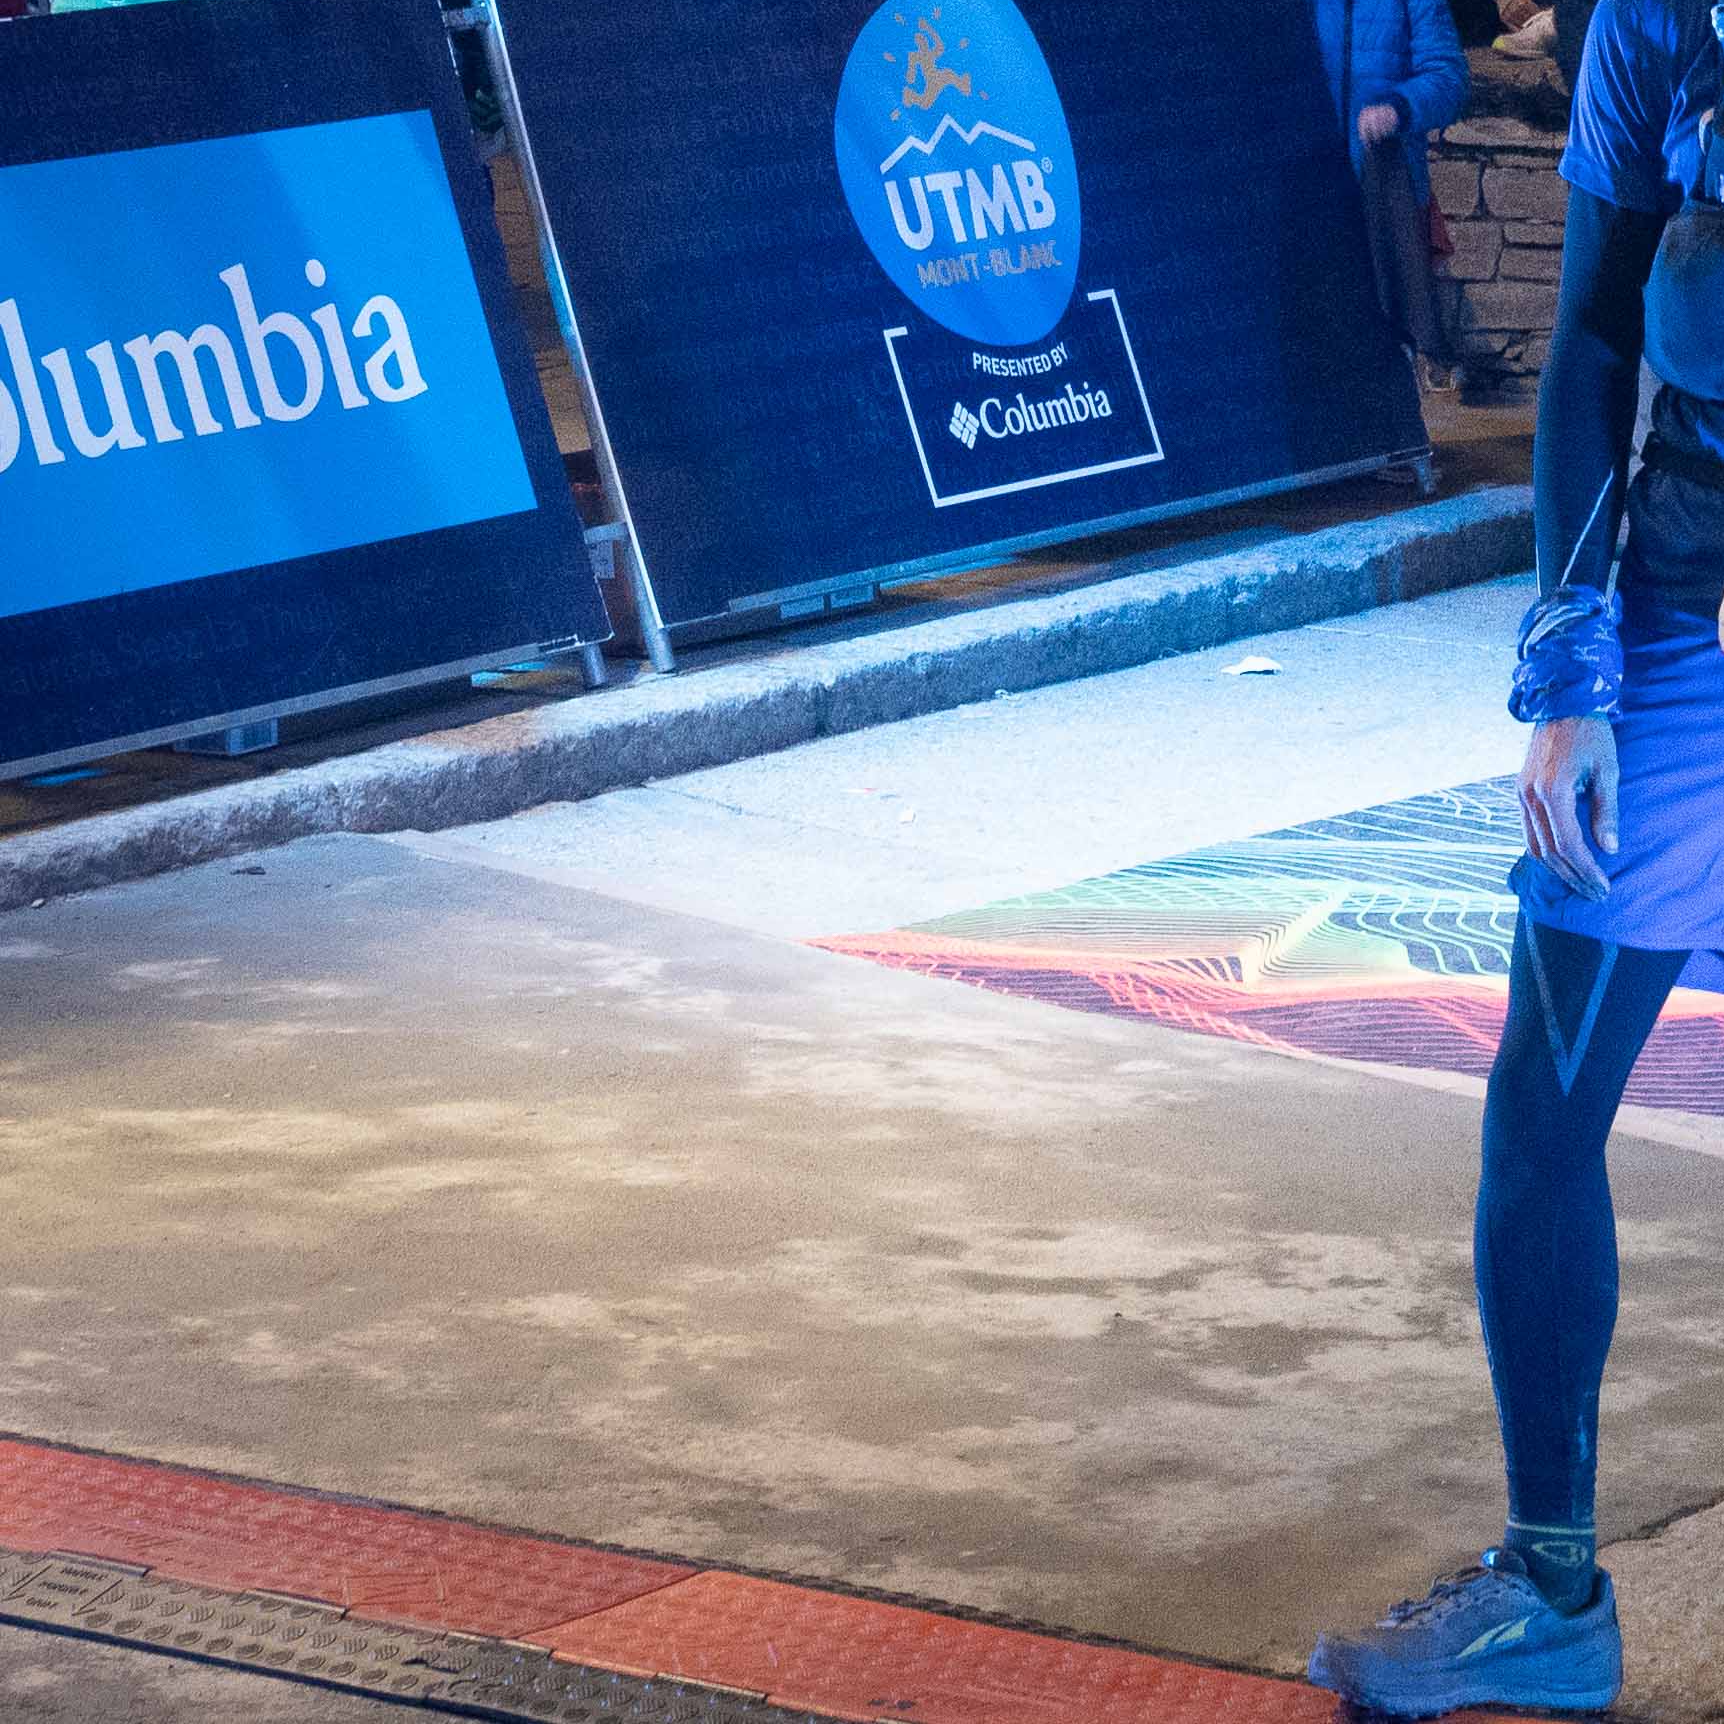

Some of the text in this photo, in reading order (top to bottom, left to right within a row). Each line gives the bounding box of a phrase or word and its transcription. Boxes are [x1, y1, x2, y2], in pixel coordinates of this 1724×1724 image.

[884, 159, 1057, 251] UTMB
[0, 258, 428, 474] lumbia
[972, 341, 1069, 377] PRESENTED BY
[979, 380, 1113, 439] Columbia
